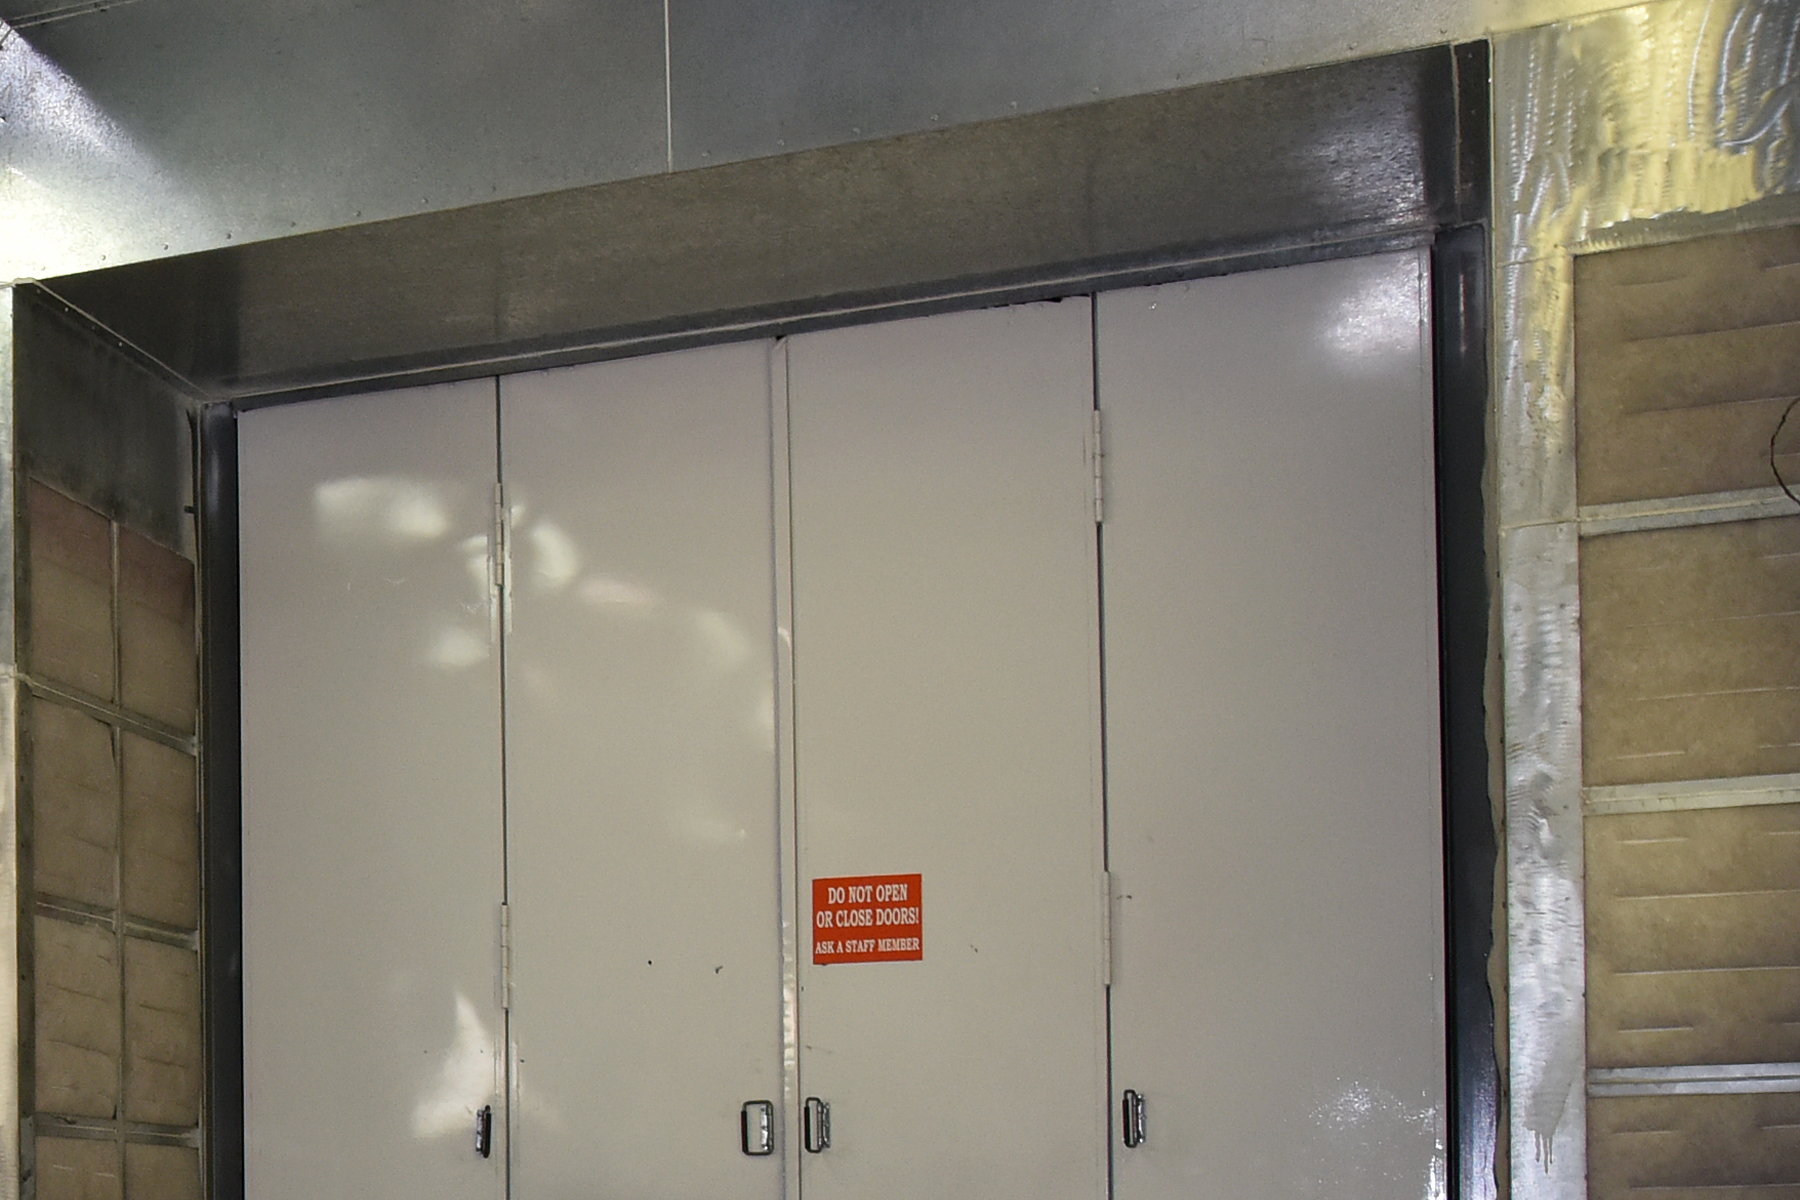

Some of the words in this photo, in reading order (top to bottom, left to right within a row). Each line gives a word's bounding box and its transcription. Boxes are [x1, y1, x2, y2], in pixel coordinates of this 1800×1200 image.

[828, 887, 845, 904] DO
[848, 885, 873, 903] NOT
[875, 883, 908, 902] OPEN
[816, 911, 833, 928] OR
[836, 909, 873, 927] CLOSE
[876, 907, 920, 925] DOORS!
[815, 941, 835, 954] ASK
[836, 941, 844, 953] A
[845, 939, 876, 953] STAFF
[878, 937, 920, 952] MEMBER
